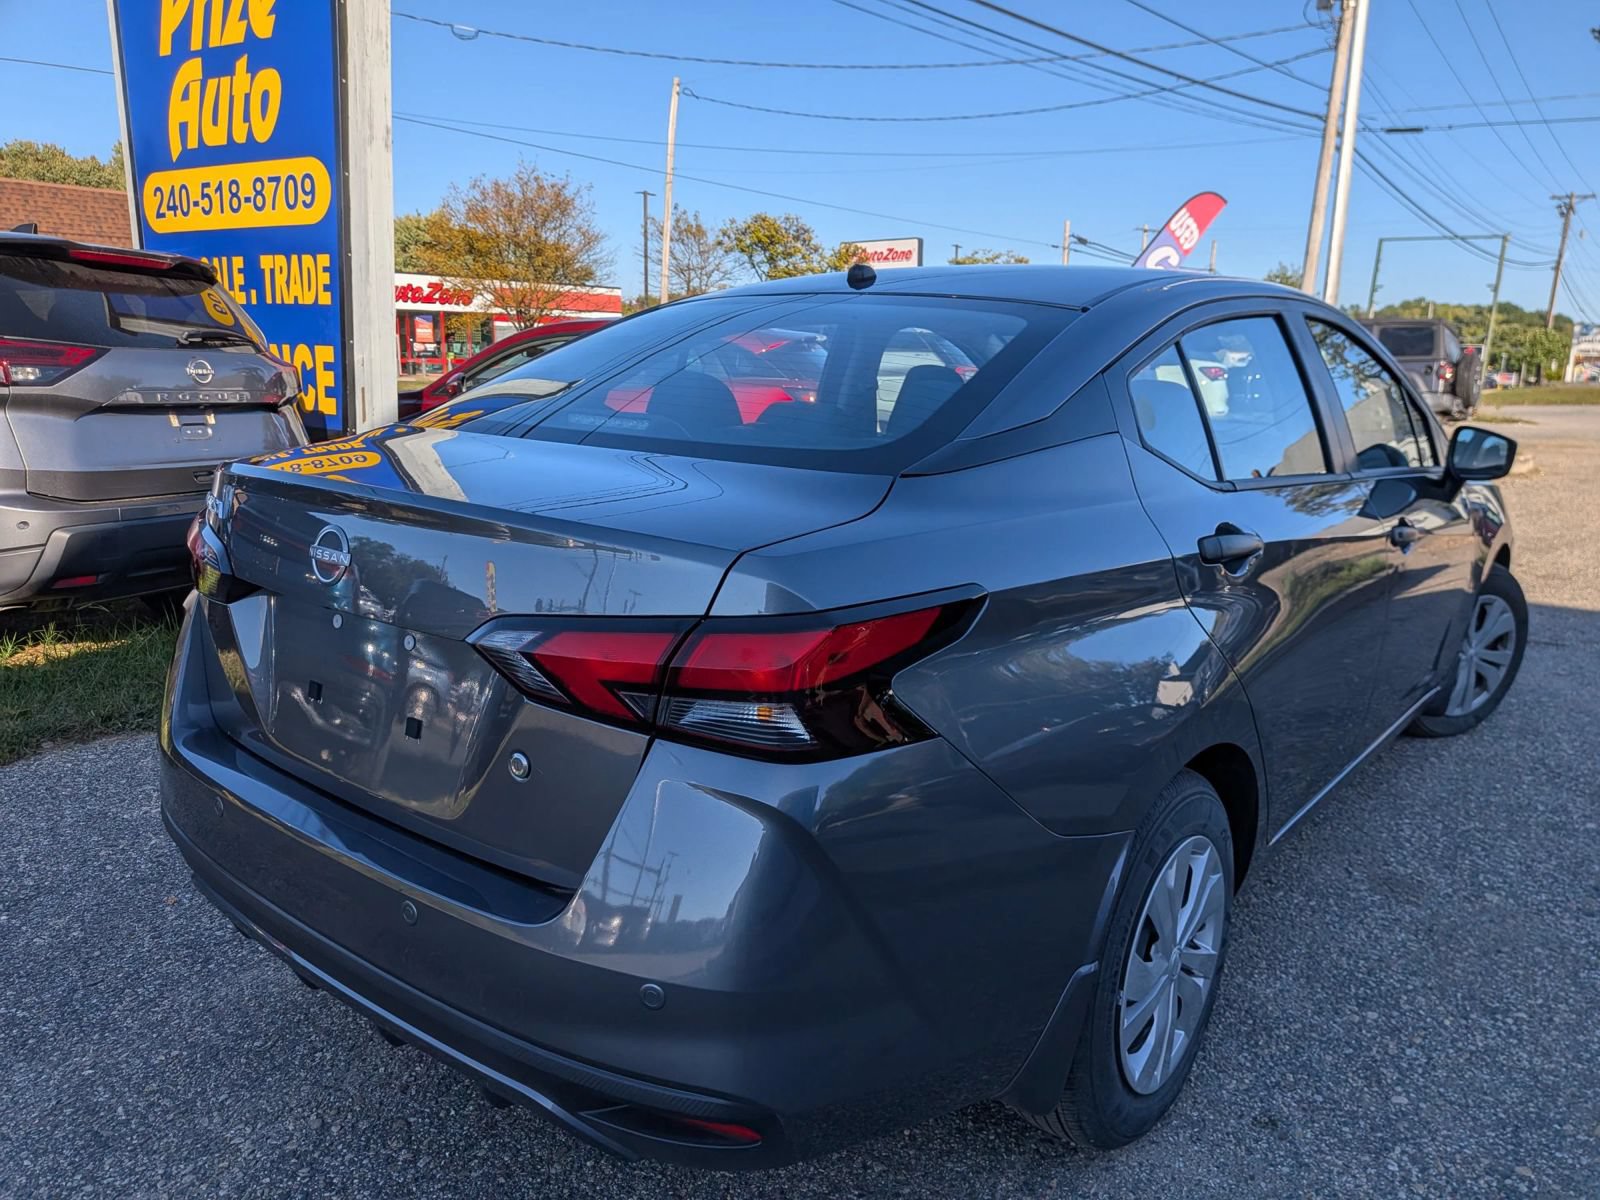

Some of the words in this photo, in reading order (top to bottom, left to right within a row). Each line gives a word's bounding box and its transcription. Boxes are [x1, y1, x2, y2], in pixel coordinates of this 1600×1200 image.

[168, 53, 282, 163] Auto
[153, 172, 316, 219] 240-518-8709
[1168, 207, 1200, 250] USED
[860, 247, 913, 262] utoZone
[259, 253, 332, 305] TRADE
[395, 282, 474, 306] utoZone
[186, 366, 215, 375] NISSAN
[156, 392, 247, 402] ROGUE
[310, 546, 349, 564] NISSAN
